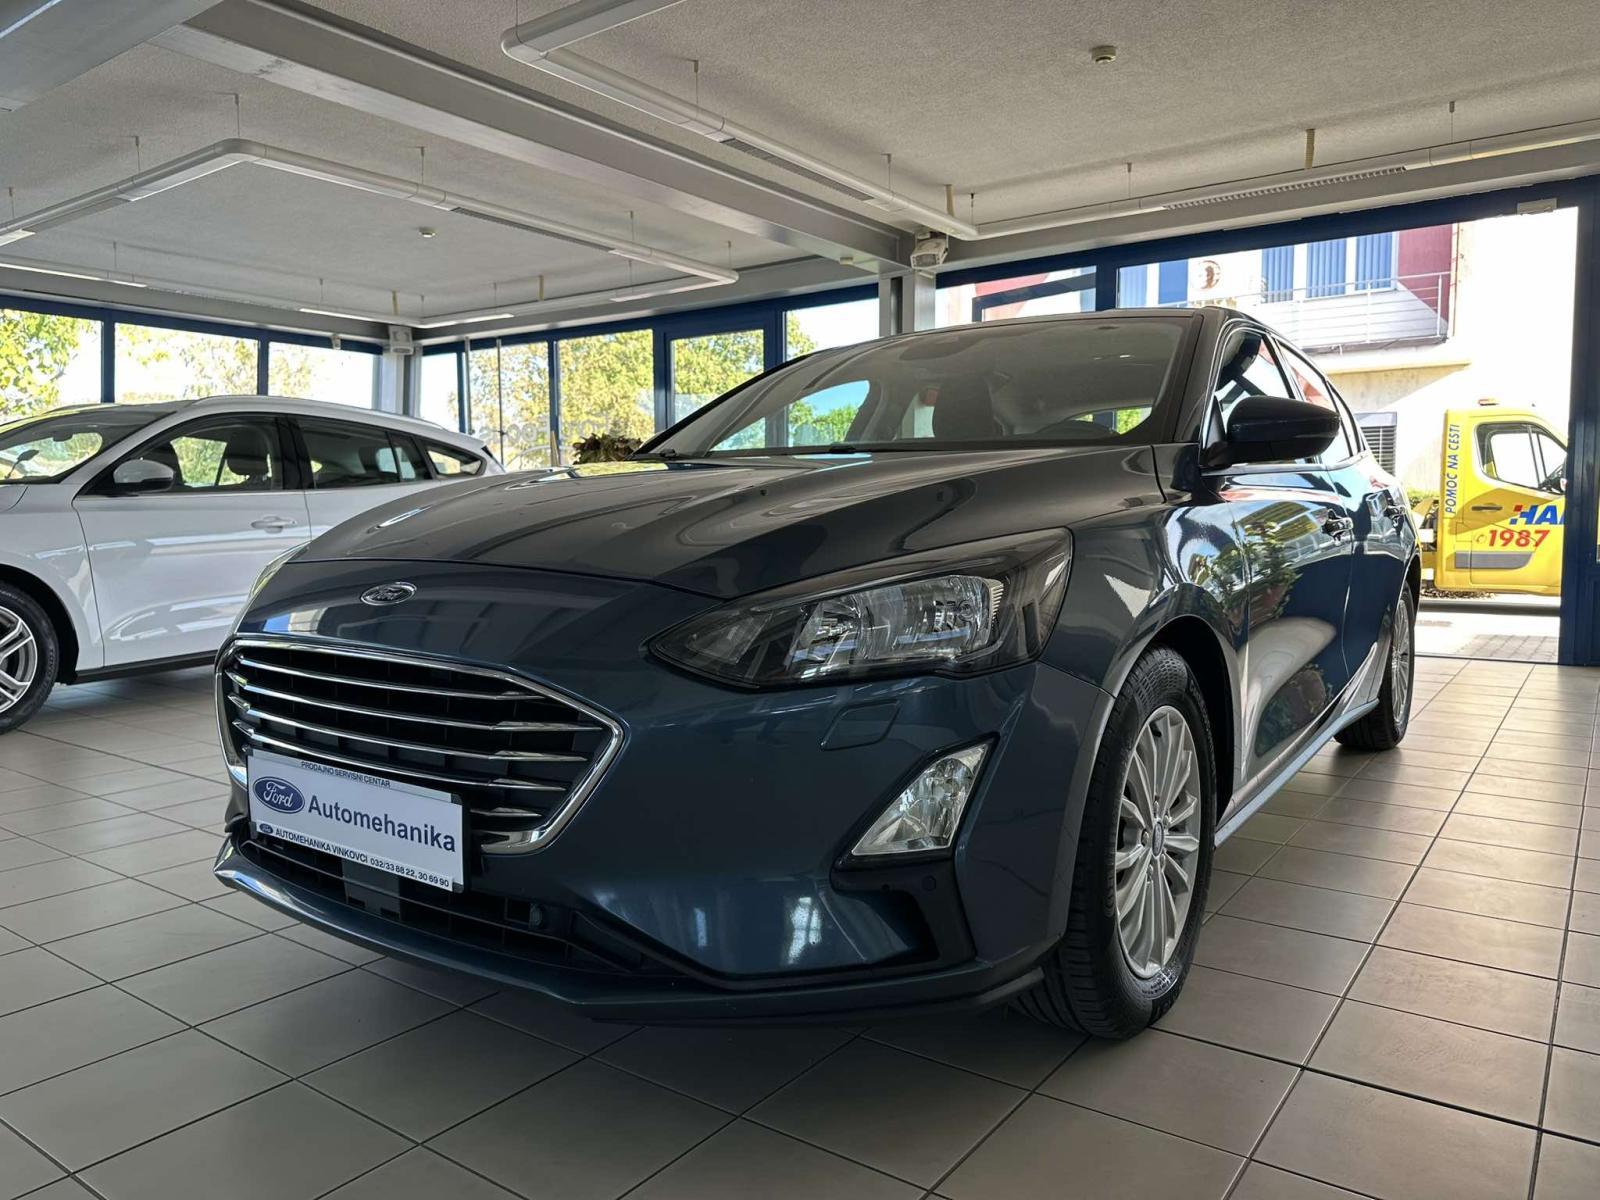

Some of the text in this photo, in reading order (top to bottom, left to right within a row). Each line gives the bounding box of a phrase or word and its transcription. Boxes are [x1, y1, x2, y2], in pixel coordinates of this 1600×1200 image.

[1445, 424, 1460, 514] POMOC NA CESTI
[1509, 505, 1565, 525] HA
[1489, 530, 1550, 547] 1987
[301, 761, 391, 787] PRODAJNO SERVISNI CENTAR
[263, 781, 294, 808] Ford
[308, 795, 455, 852] Automehanika
[275, 828, 331, 851] AUTOMEHANIKA
[331, 843, 368, 863] VINKOVCI
[370, 857, 395, 871] 032/33
[418, 871, 428, 881] 30
[439, 878, 450, 887] 90
